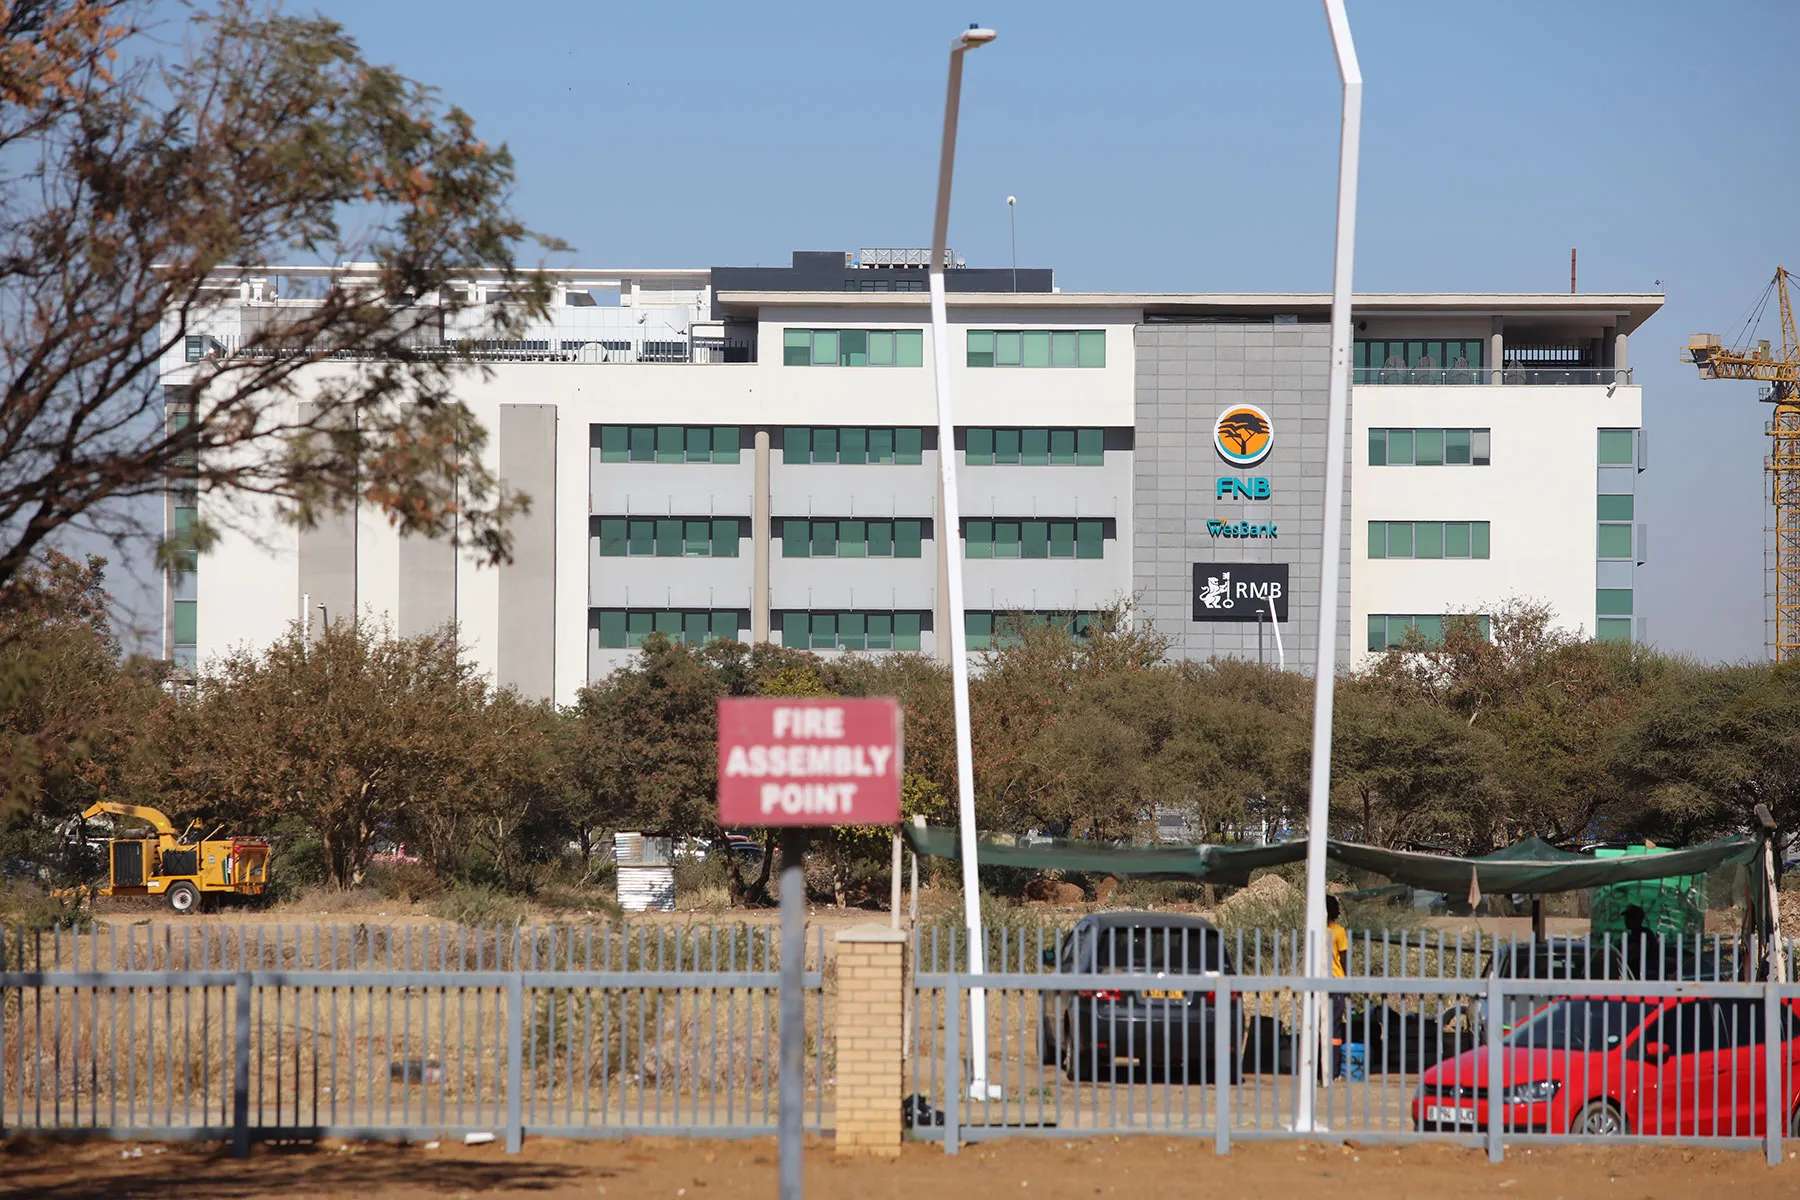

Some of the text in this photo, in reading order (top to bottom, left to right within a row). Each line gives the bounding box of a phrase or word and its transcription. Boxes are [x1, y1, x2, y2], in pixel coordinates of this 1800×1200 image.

[1216, 477, 1271, 500] FNB
[1206, 518, 1277, 538] WesBank
[1236, 582, 1282, 599] RMB
[772, 707, 845, 738] FIRE
[725, 744, 892, 777] ASSEMBLY
[760, 783, 857, 815] POINT
